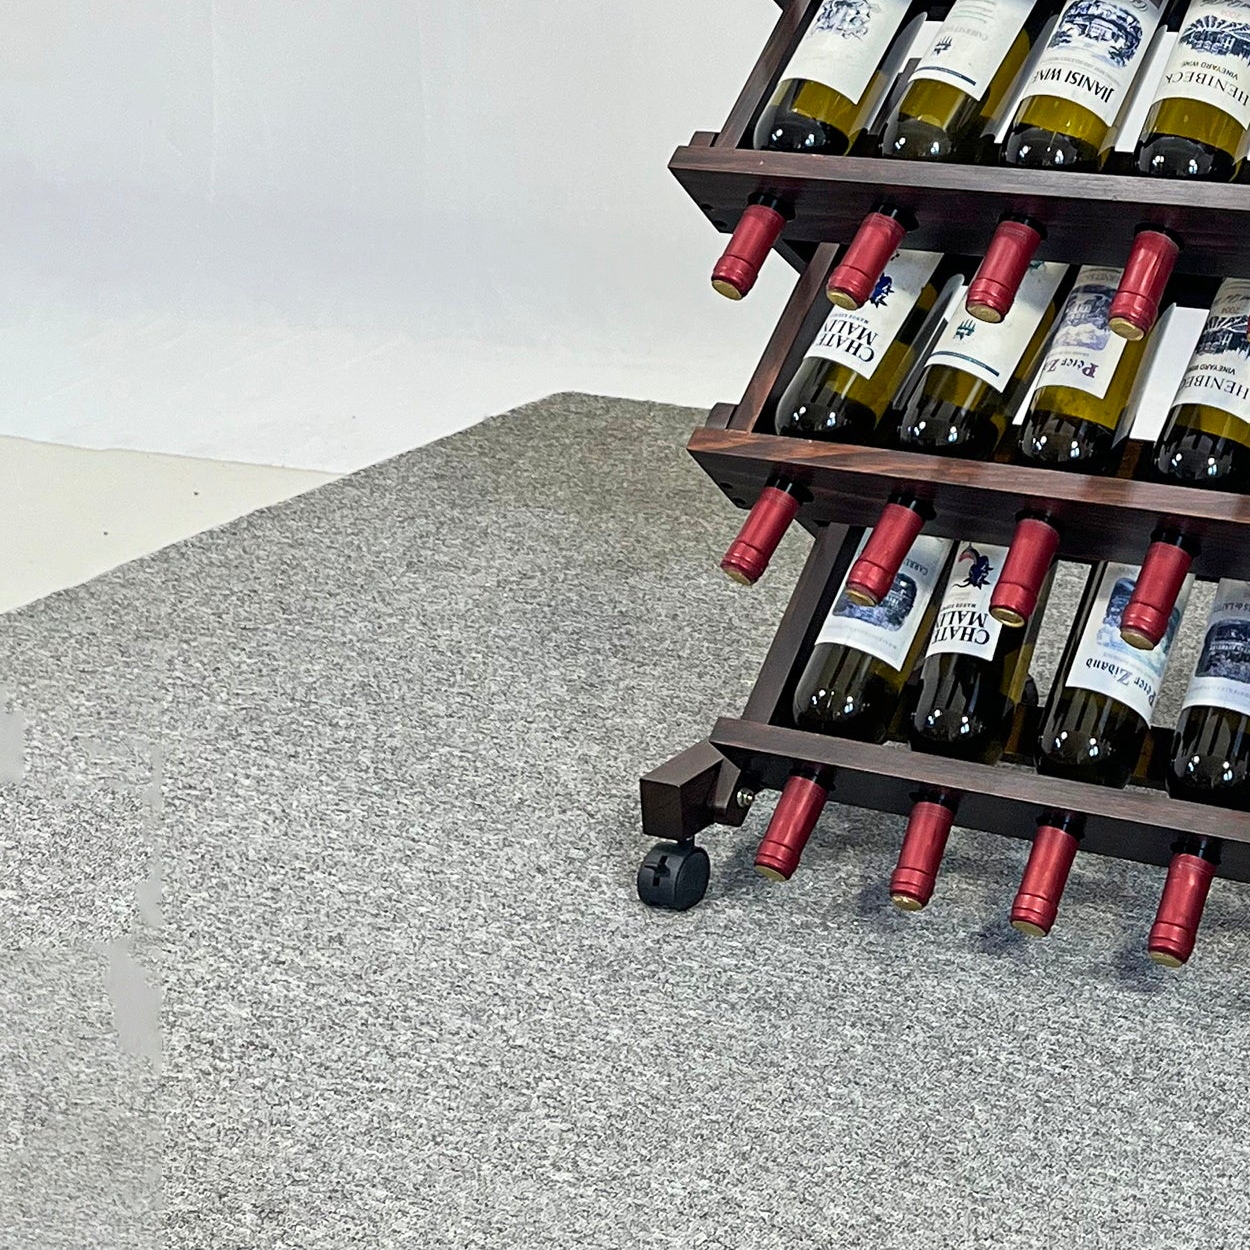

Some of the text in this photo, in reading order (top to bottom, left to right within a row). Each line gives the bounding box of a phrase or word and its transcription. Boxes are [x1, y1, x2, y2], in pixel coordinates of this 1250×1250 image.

[1200, 62, 1239, 81] VINEYARD
[1064, 70, 1115, 104] JIANISI
[1163, 71, 1250, 107] HENIBECK
[1200, 363, 1237, 376] VINEYARD
[903, 558, 929, 576] CARRU
